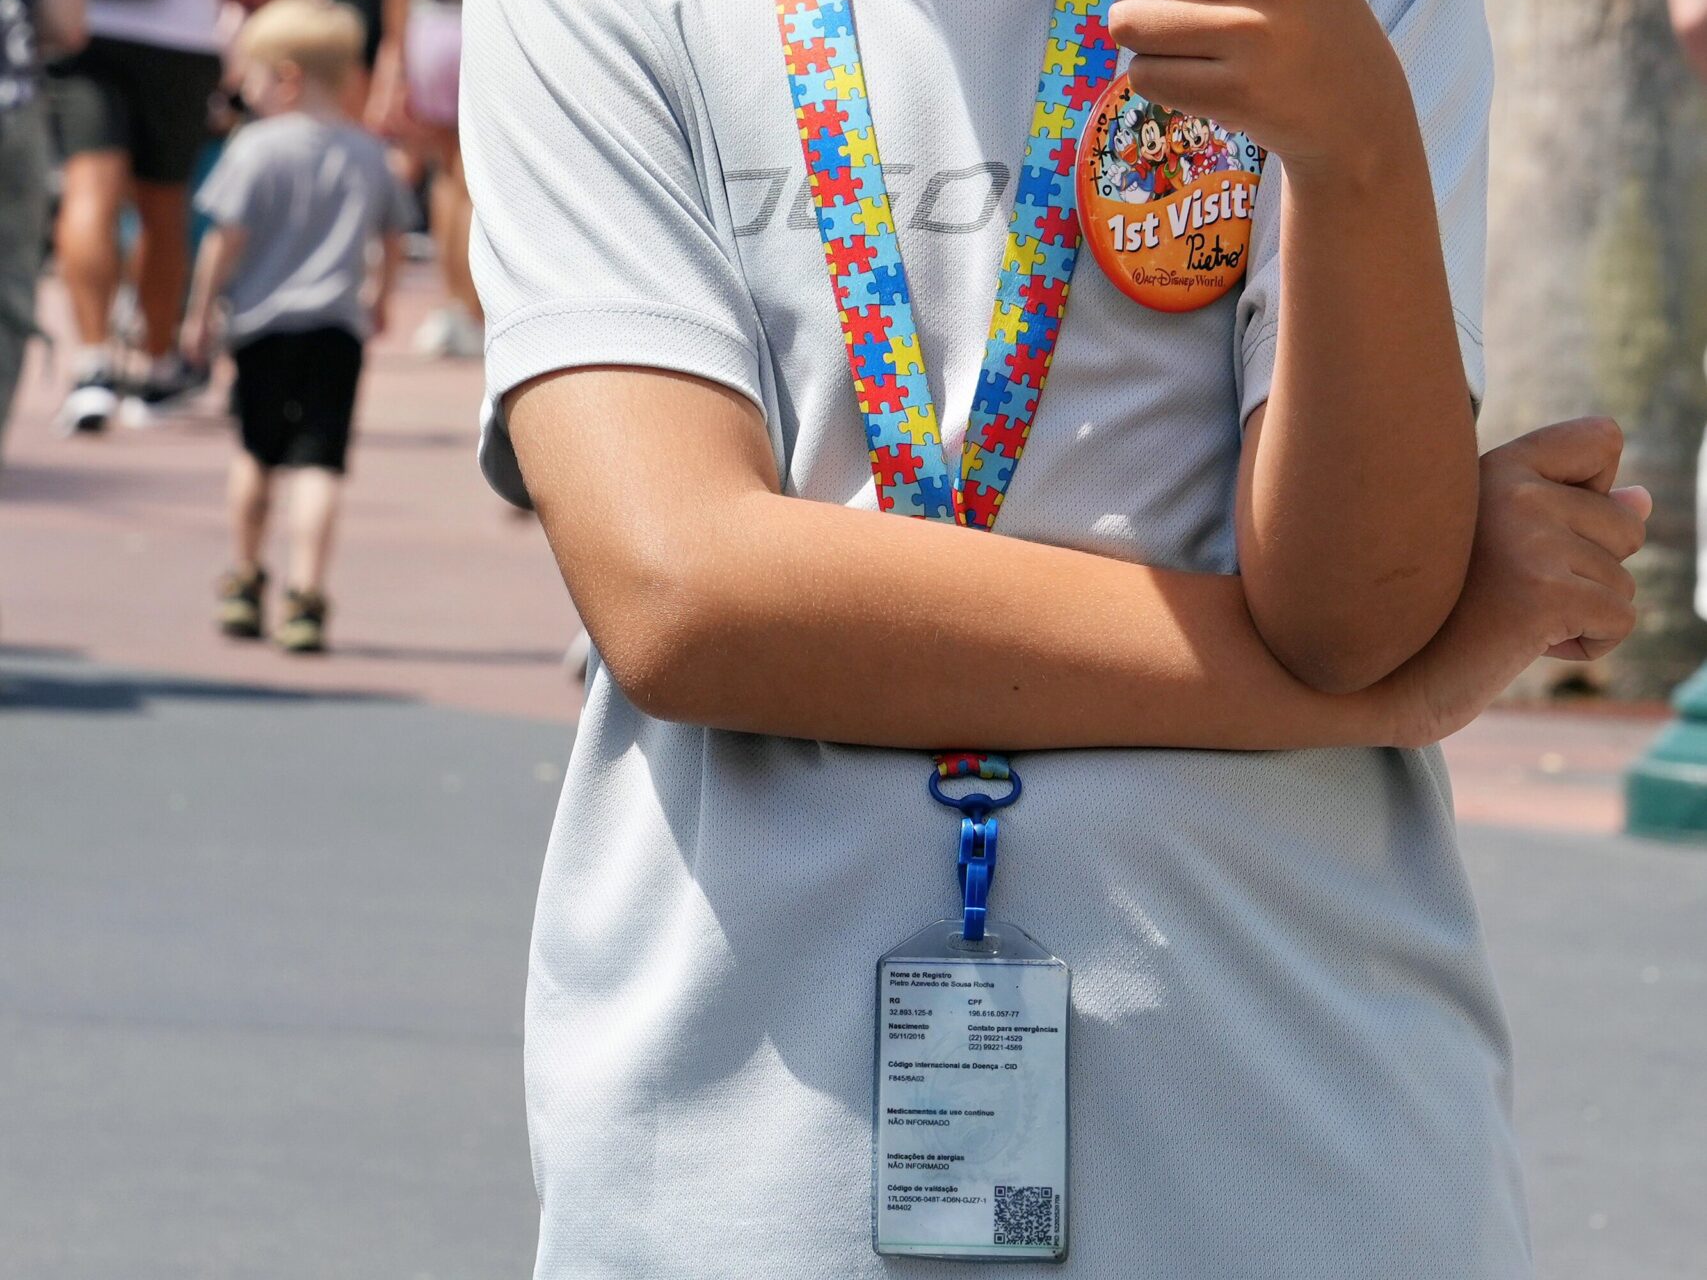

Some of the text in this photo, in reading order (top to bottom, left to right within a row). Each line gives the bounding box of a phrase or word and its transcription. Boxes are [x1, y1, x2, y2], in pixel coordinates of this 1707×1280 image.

[1108, 212, 1160, 252] 1st
[1186, 233, 1244, 271] Pietro
[890, 971, 952, 980] Nome de Registro
[910, 980, 940, 988] Azevedo
[973, 981, 995, 989] Rocha
[889, 997, 901, 1005] RG
[967, 998, 983, 1006] CPF
[1014, 1025, 1059, 1034] emergências
[968, 1034, 983, 1042] (22)
[968, 1043, 983, 1051] (22)
[888, 1060, 913, 1069] Código
[972, 1062, 999, 1070] Doença
[887, 1107, 937, 1115] Medicamentos
[888, 1118, 950, 1126] NÃO INFORMADO
[887, 1153, 965, 1162] Indicações de alergias
[888, 1161, 950, 1170] NÃO INFORMADO
[887, 1184, 913, 1193] Código
[924, 1185, 959, 1194] validação
